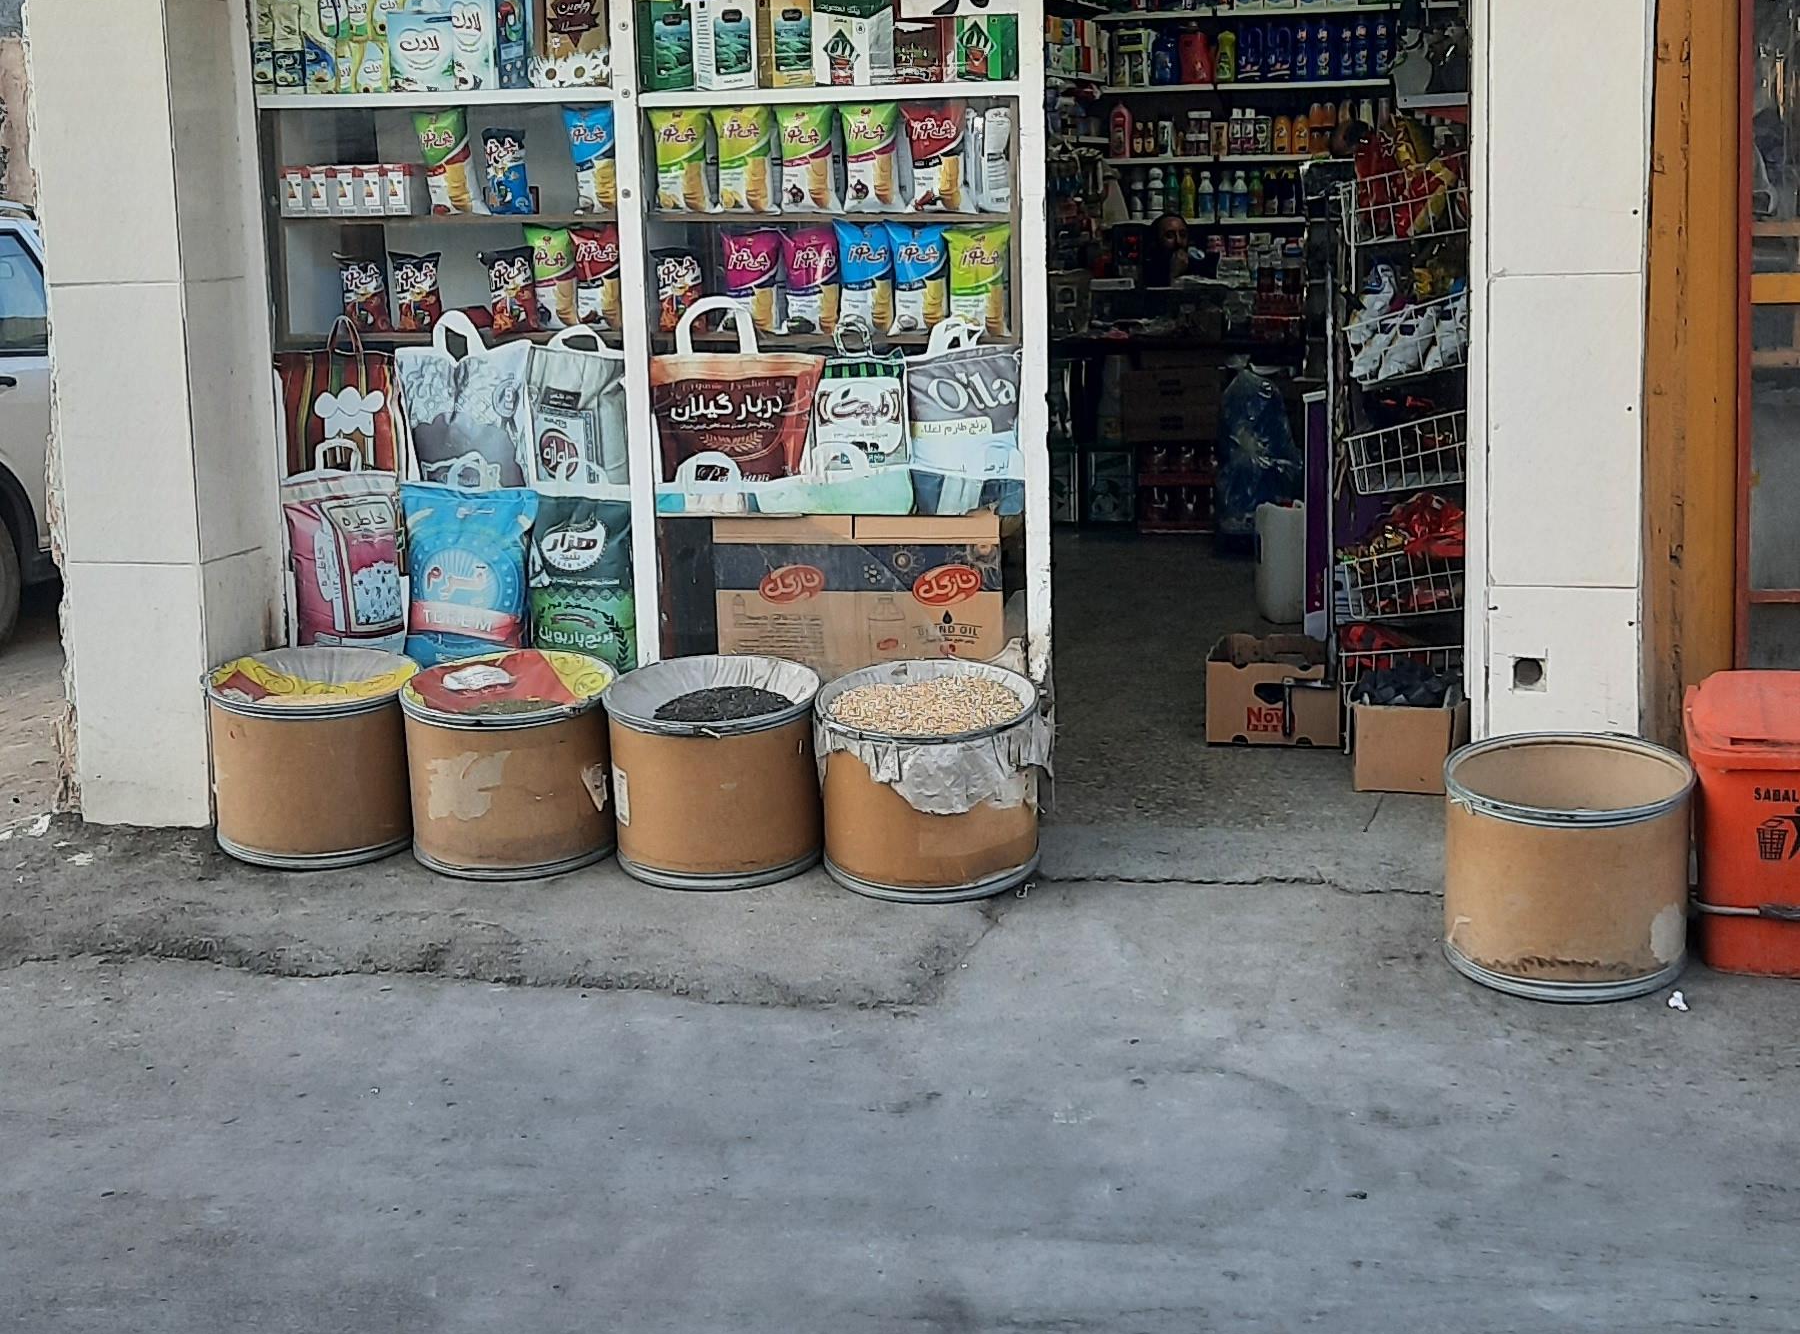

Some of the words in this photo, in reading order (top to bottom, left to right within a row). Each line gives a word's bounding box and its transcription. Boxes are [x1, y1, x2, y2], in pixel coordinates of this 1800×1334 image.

[400, 34, 440, 52] لادن
[670, 393, 733, 422] گیلان
[735, 394, 783, 421] دربار
[546, 533, 598, 553] هزار
[585, 630, 614, 649] برنج
